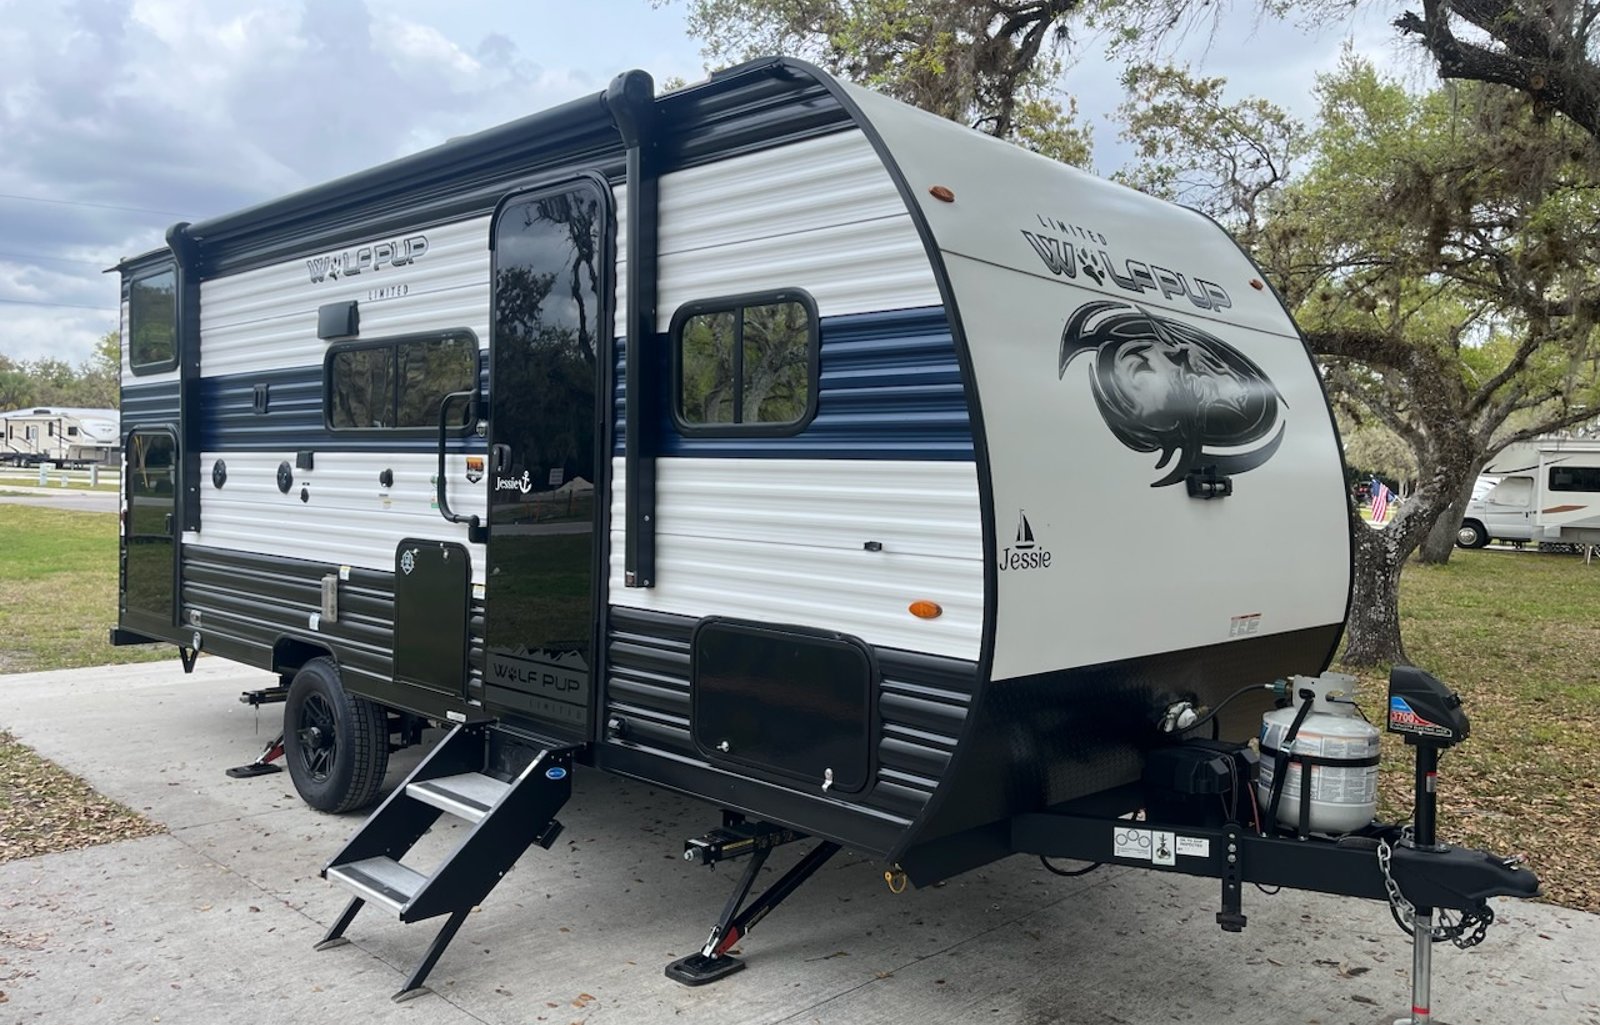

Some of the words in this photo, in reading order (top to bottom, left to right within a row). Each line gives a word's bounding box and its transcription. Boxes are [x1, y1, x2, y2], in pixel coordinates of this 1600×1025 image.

[1036, 213, 1108, 246] LIMITED
[368, 284, 409, 301] LIMITED
[495, 476, 520, 491] Jessie
[999, 546, 1052, 571] Jessie
[542, 673, 580, 693] PUP
